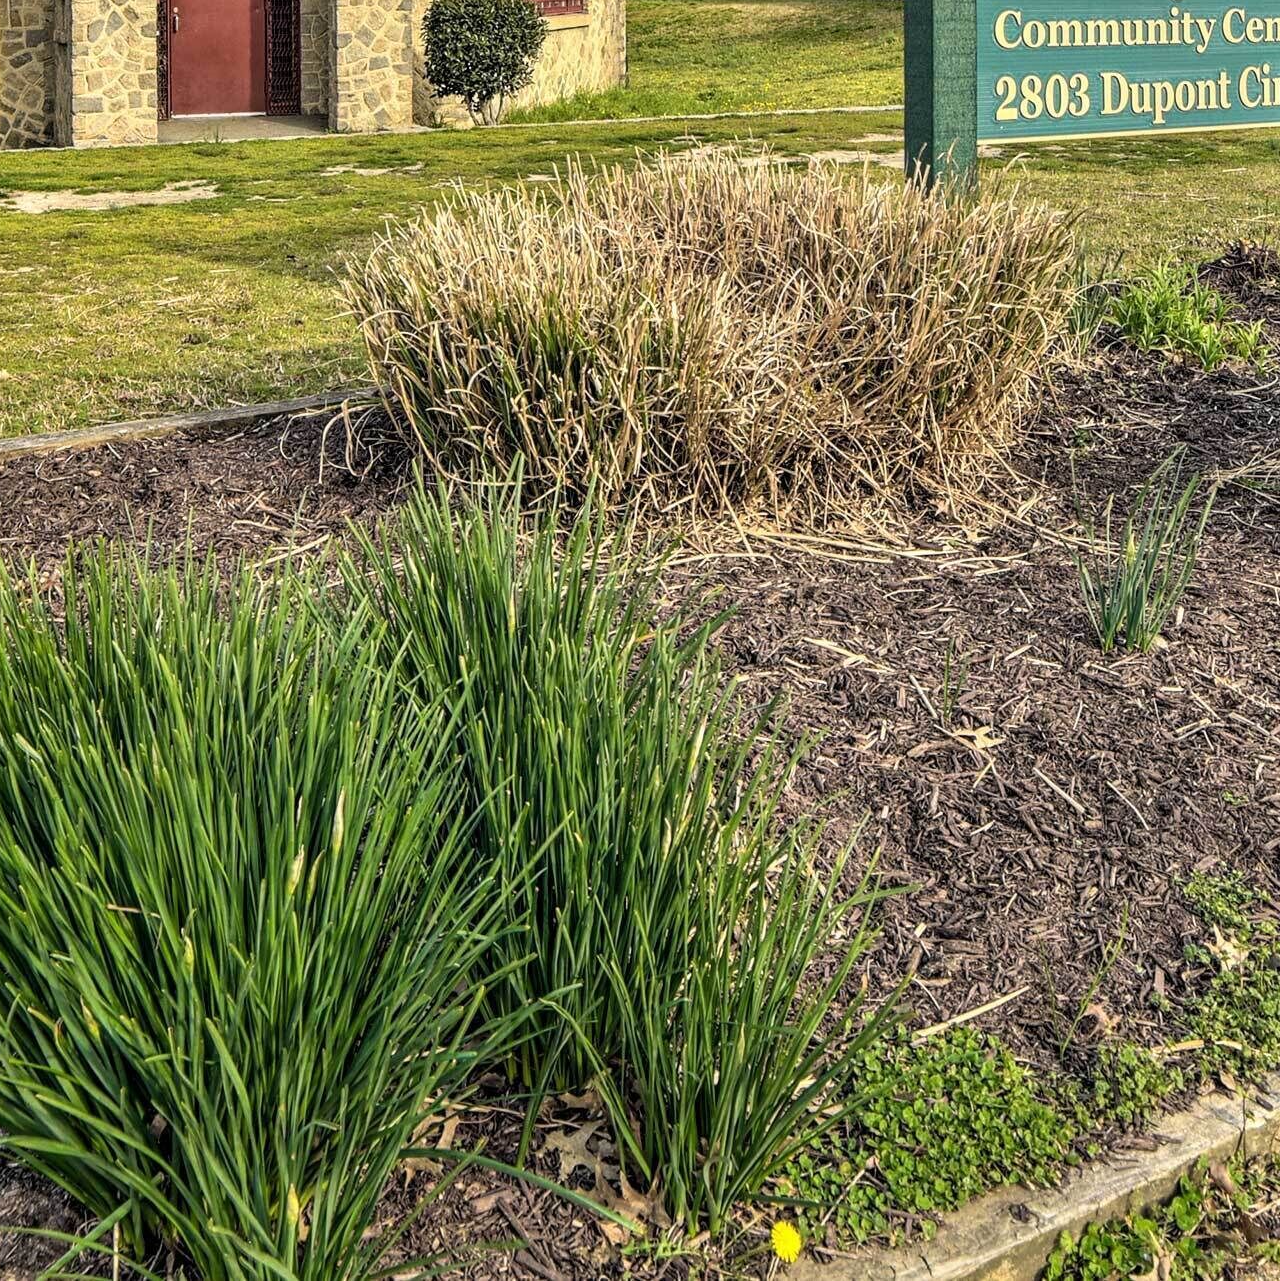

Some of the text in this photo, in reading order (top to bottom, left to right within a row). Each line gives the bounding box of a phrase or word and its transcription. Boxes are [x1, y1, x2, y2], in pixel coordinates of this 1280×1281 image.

[993, 7, 1217, 54] Community
[995, 72, 1091, 122] 2803
[1100, 69, 1231, 125] Dupont
